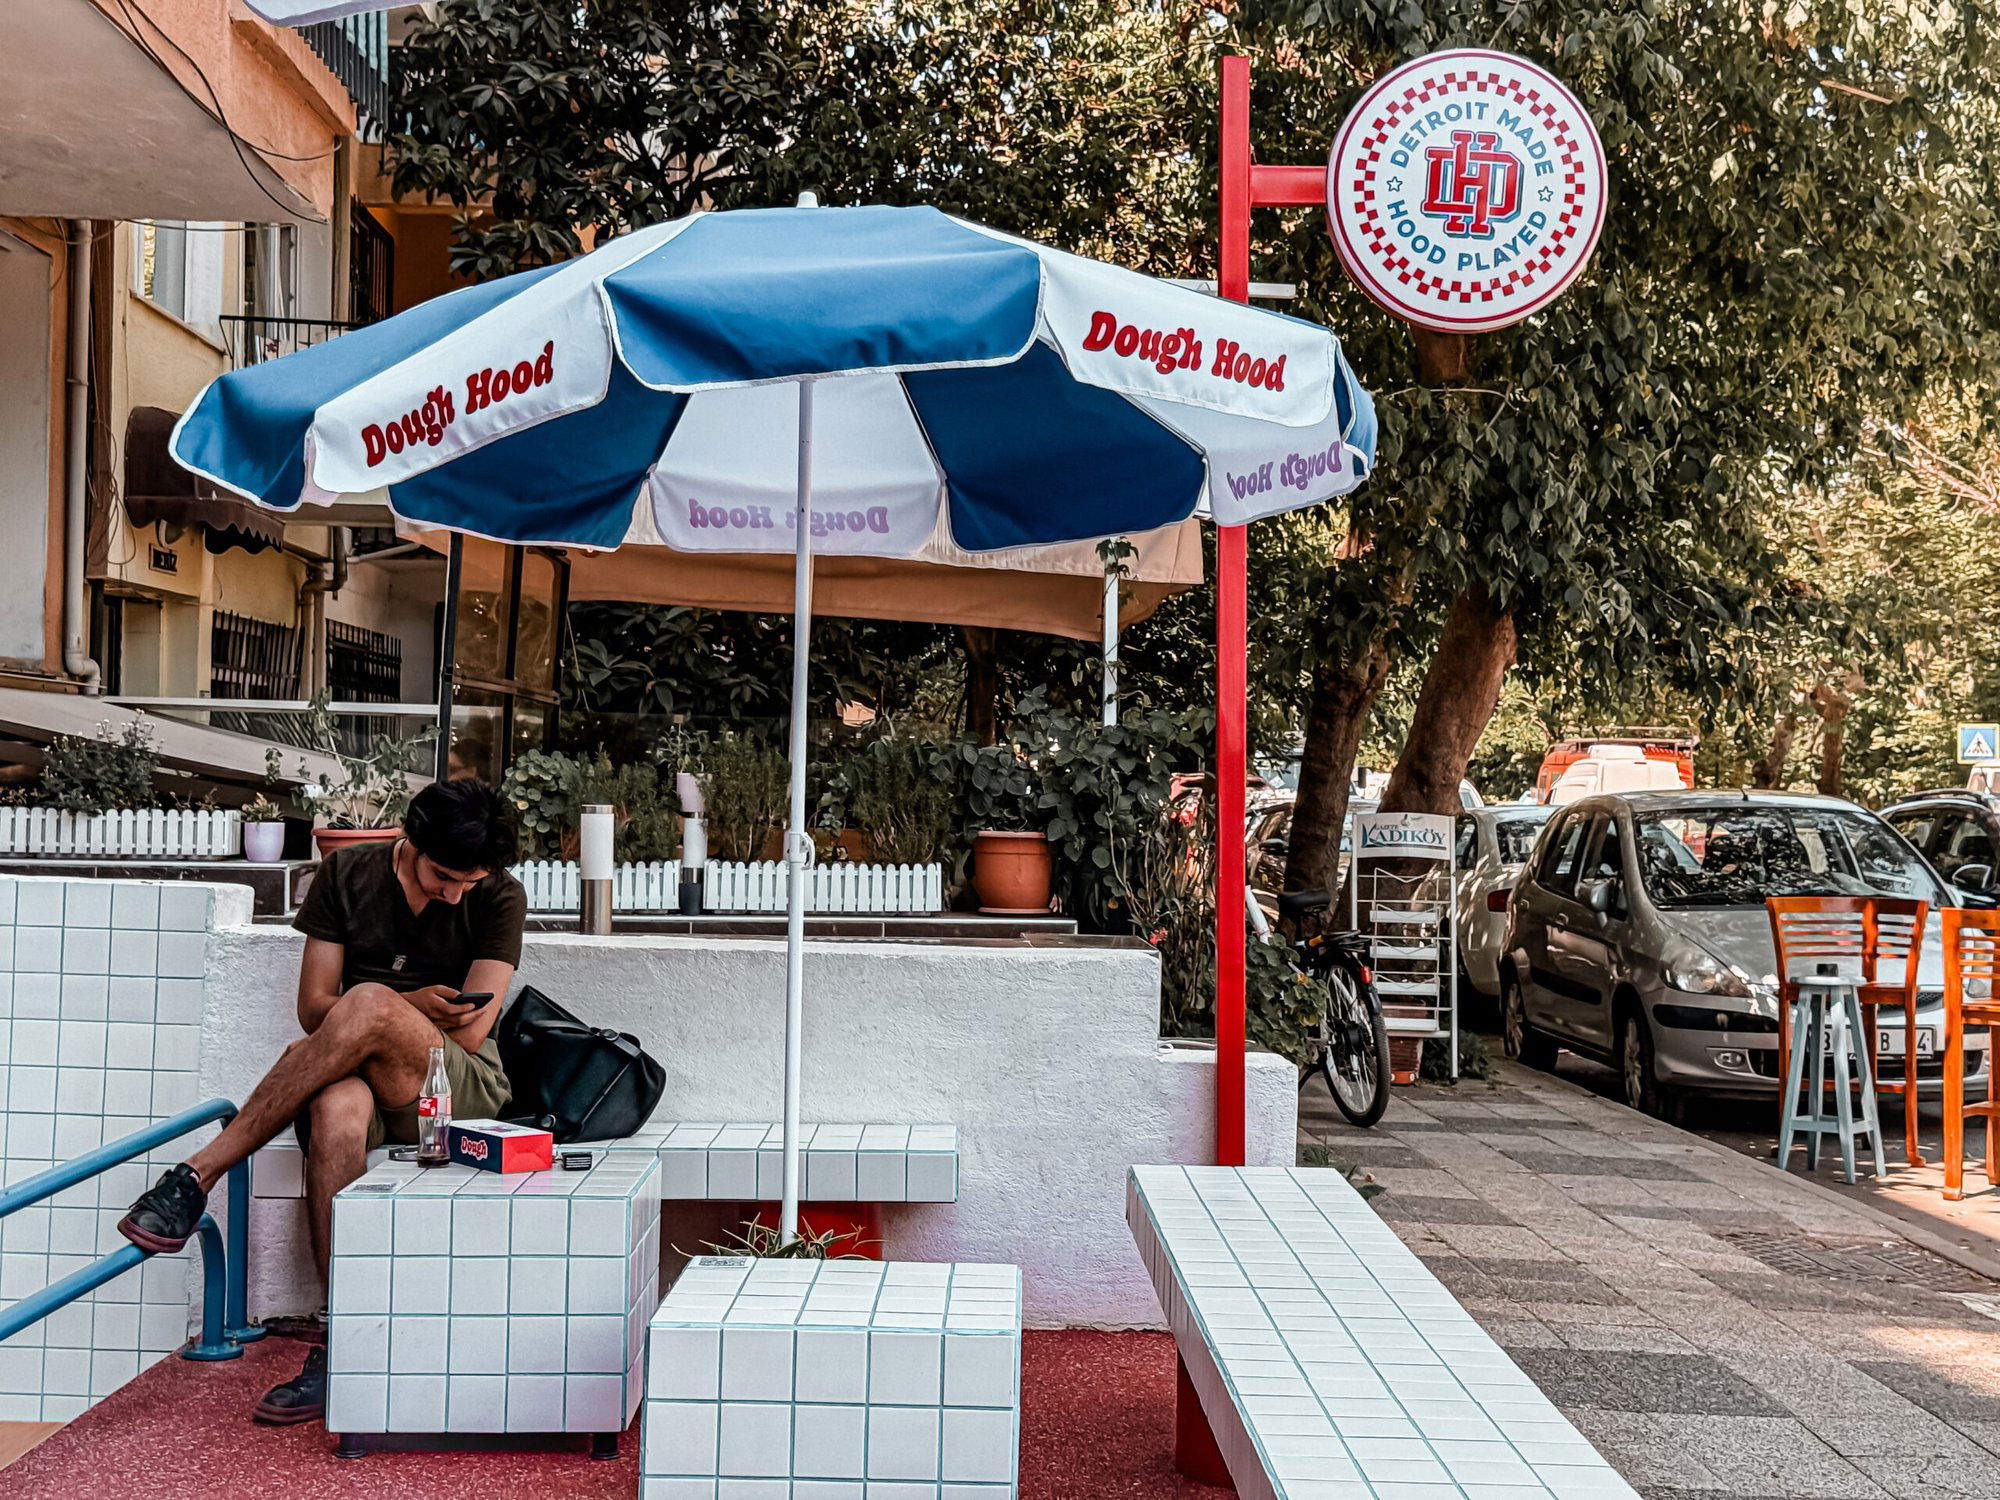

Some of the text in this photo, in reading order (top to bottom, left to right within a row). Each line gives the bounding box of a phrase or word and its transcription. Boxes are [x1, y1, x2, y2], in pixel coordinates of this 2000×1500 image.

[1390, 102, 1554, 177] DETROIT MADE
[1387, 200, 1547, 271] HOOD PLAYED
[1082, 311, 1287, 392] Dough Hood
[361, 340, 554, 468] Dough Hood
[1361, 823, 1447, 849] KADIKÖY
[461, 1136, 488, 1160] Dough
